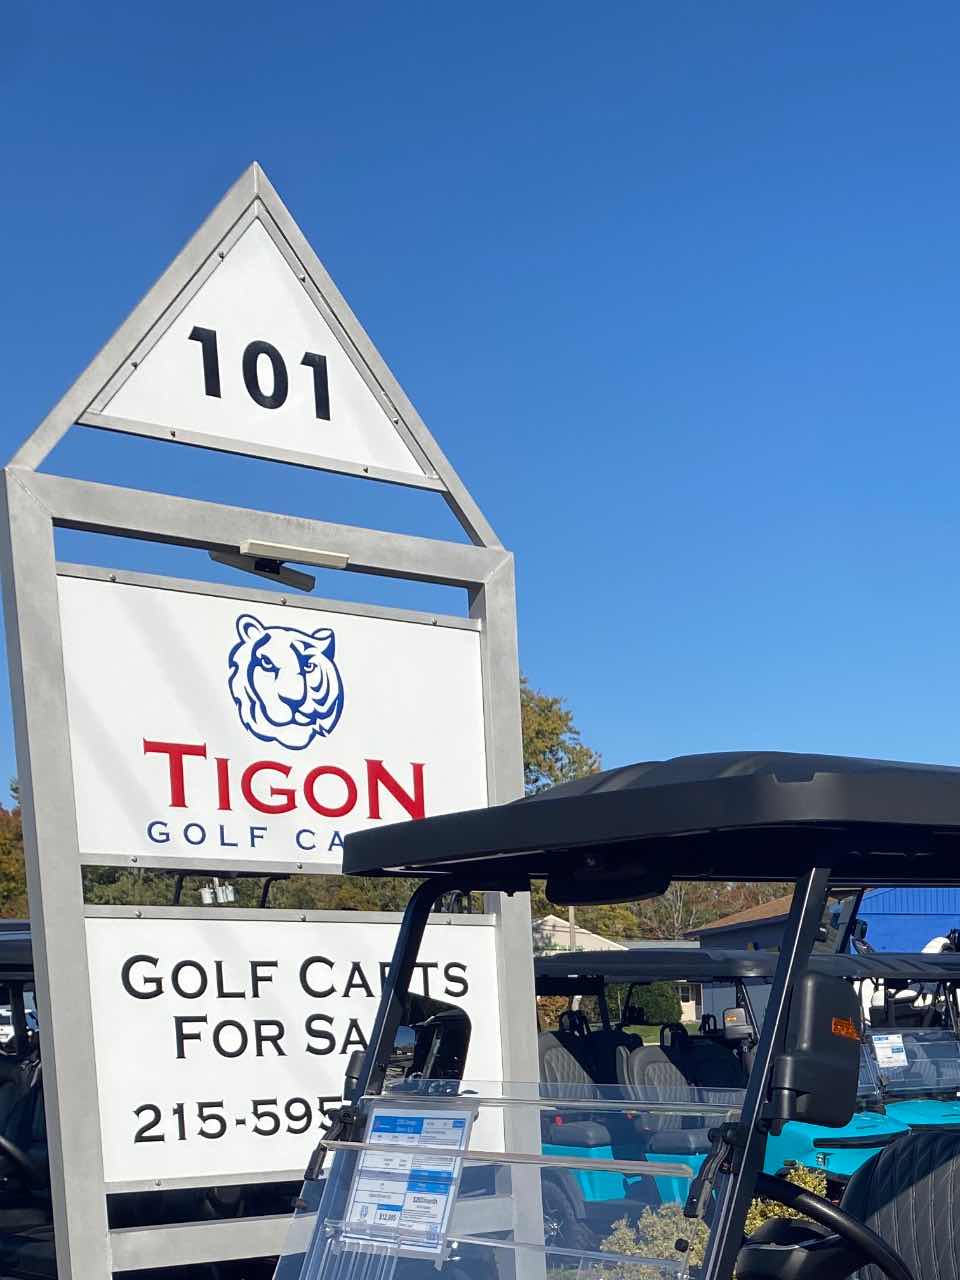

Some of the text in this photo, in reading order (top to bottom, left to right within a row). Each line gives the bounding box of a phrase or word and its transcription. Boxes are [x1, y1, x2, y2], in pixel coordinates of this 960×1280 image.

[188, 326, 331, 421] 101
[143, 738, 426, 820] TIGON
[147, 821, 268, 848] GOLF
[121, 955, 278, 999] GOLF
[174, 1013, 369, 1058] FOR SA
[133, 1096, 343, 1142] 215-595
